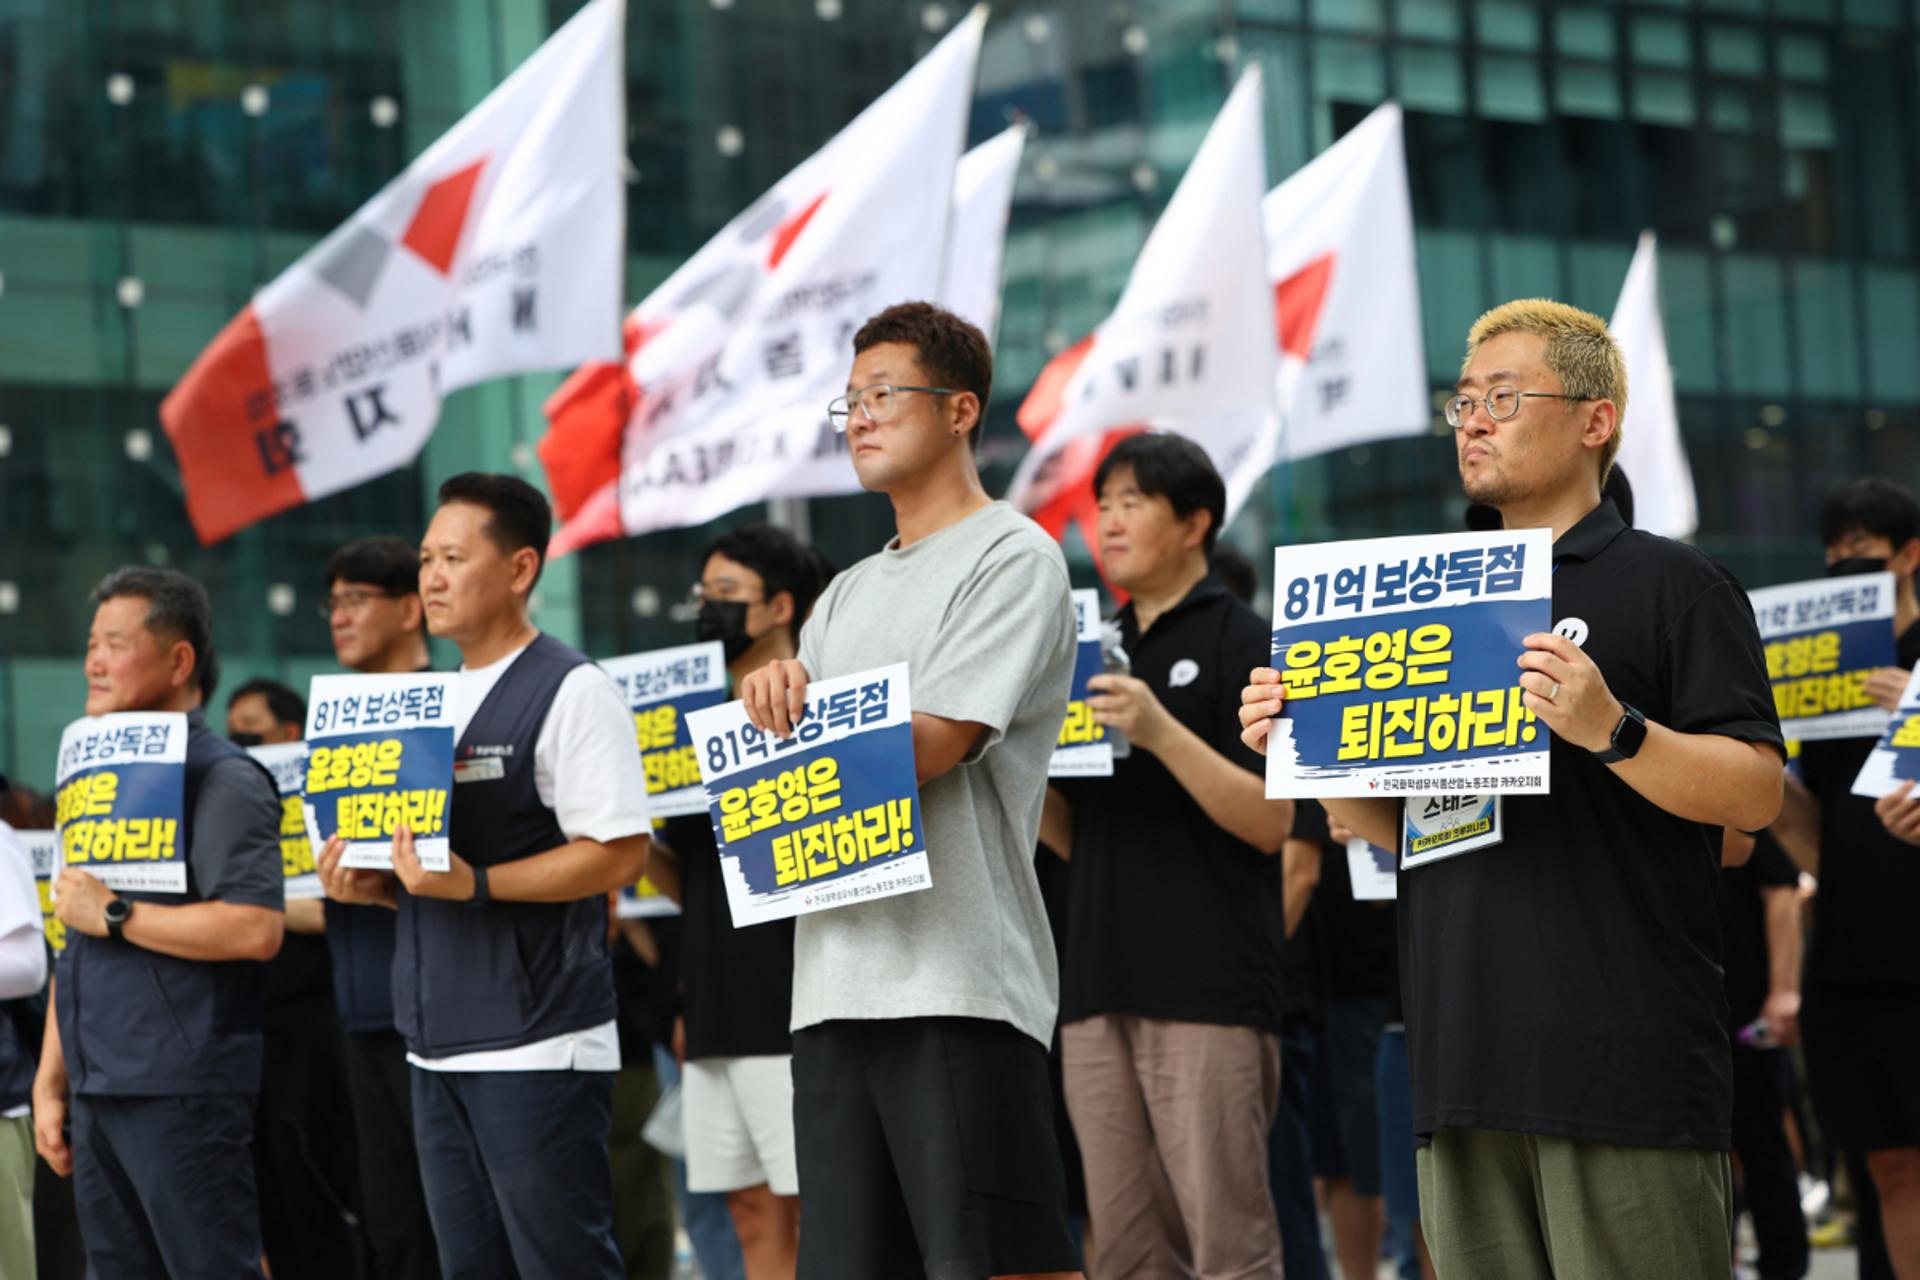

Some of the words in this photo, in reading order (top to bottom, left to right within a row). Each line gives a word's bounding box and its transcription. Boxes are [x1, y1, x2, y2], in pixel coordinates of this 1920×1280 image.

[1284, 565, 1366, 620] 81억
[1372, 544, 1526, 606] 보상독점
[1281, 624, 1452, 700] 윤호영은
[314, 695, 362, 731] 81억
[363, 685, 444, 725] 보상독점
[707, 722, 769, 773] 81억
[775, 679, 889, 749] 상독점
[83, 725, 170, 761] 보상독점
[306, 739, 403, 794] 윤호영은
[336, 788, 447, 839] 퇴진하라!
[720, 757, 842, 843] 윤호영은
[1500, 776, 1541, 788] 카카오지회
[772, 798, 914, 886] 퇴진하라!
